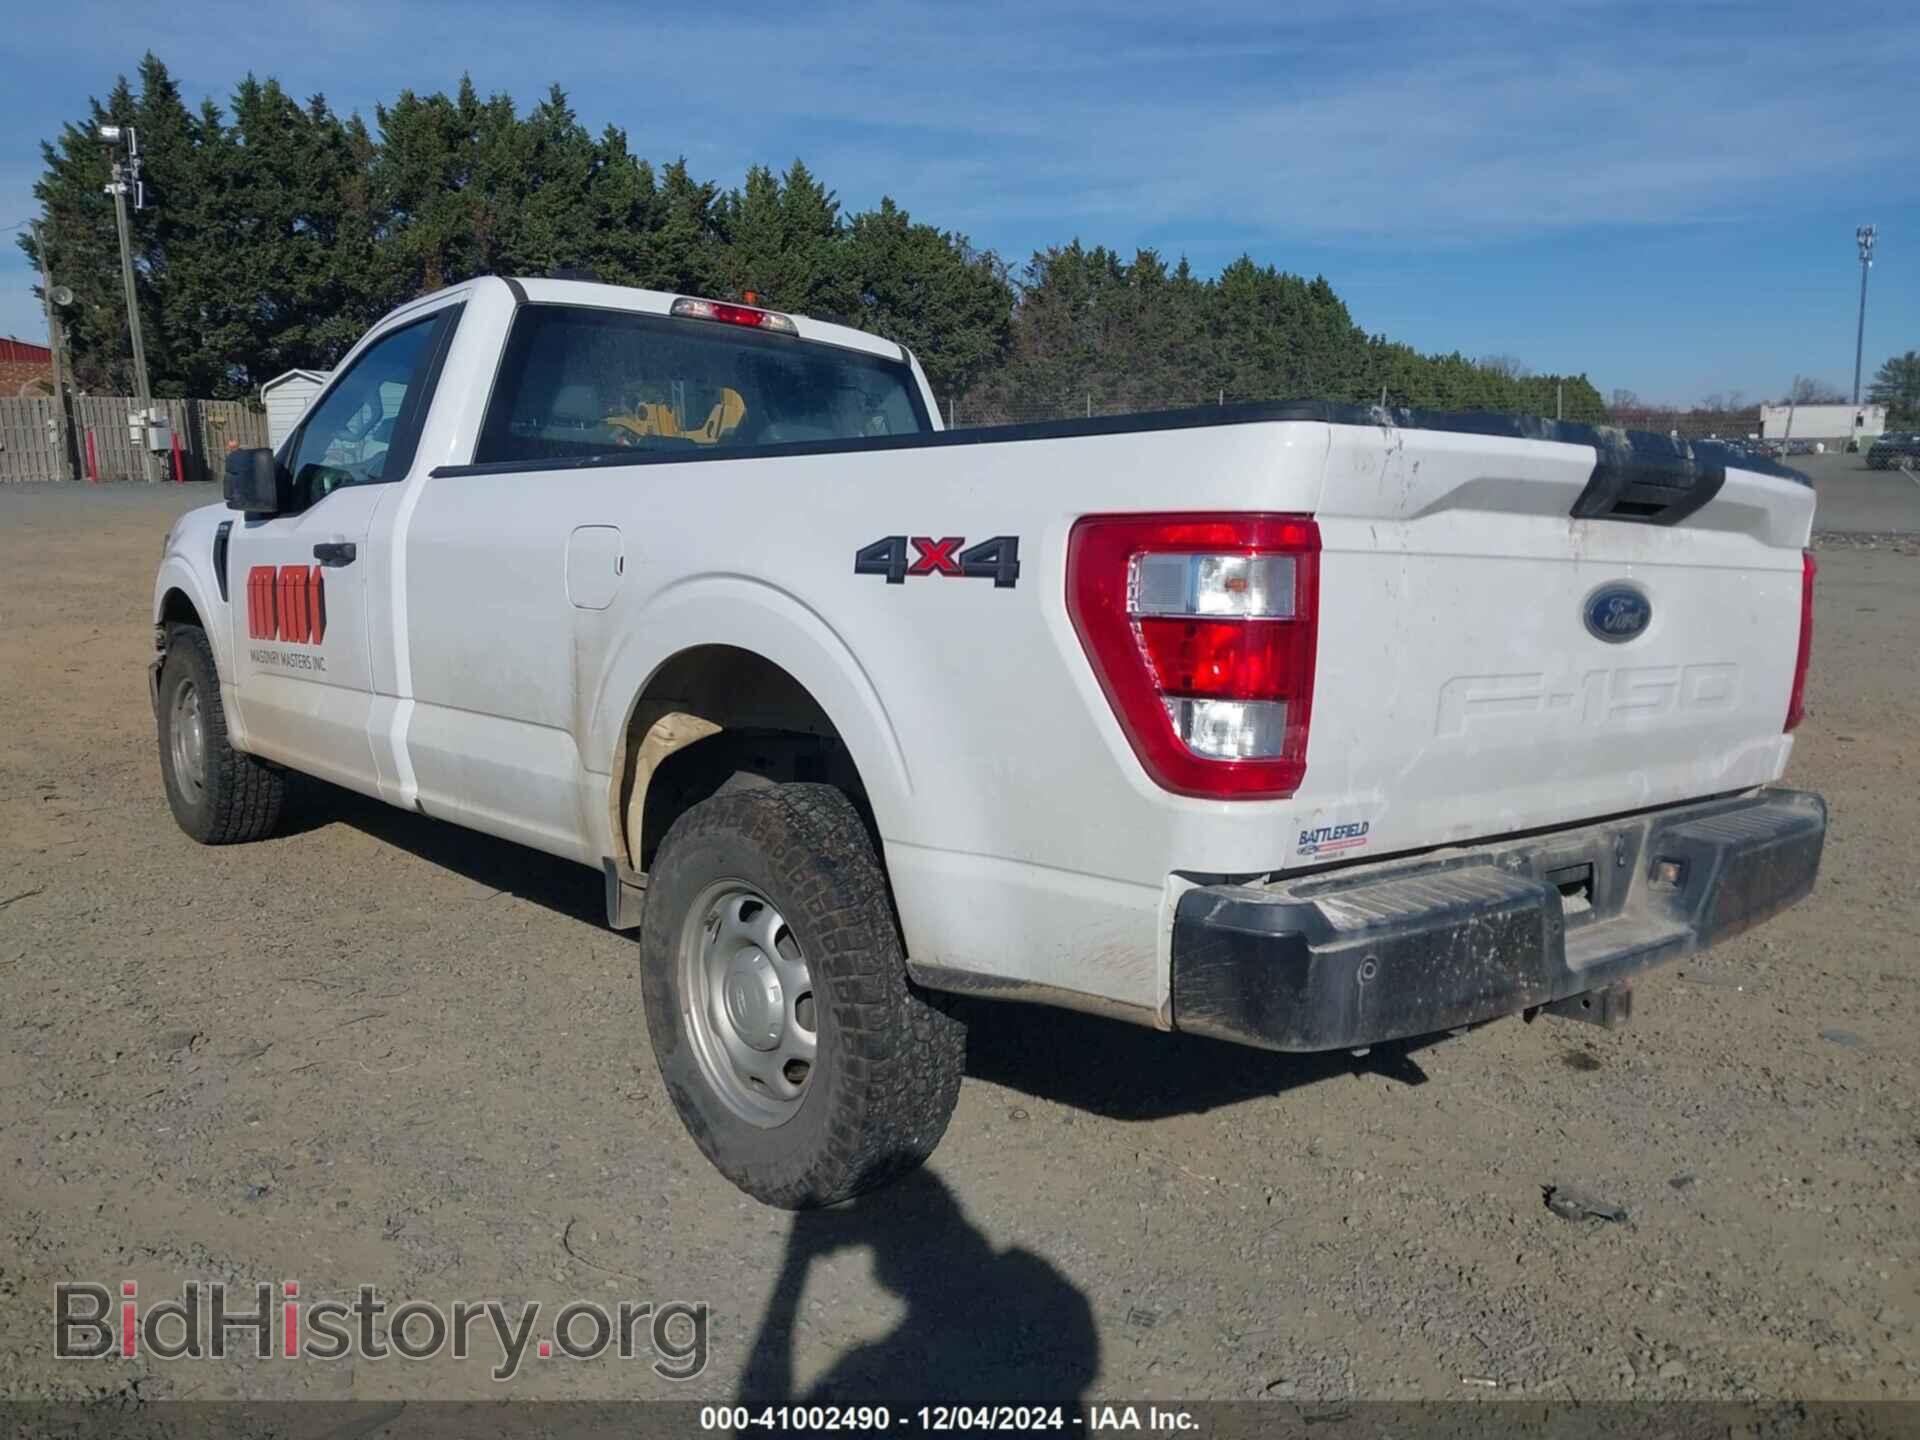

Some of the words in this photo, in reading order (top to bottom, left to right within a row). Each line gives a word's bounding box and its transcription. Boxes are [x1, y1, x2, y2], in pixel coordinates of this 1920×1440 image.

[1604, 598, 1646, 629] Ford
[281, 651, 312, 670] MASTERS
[1298, 821, 1370, 845] BATTLEFIELD
